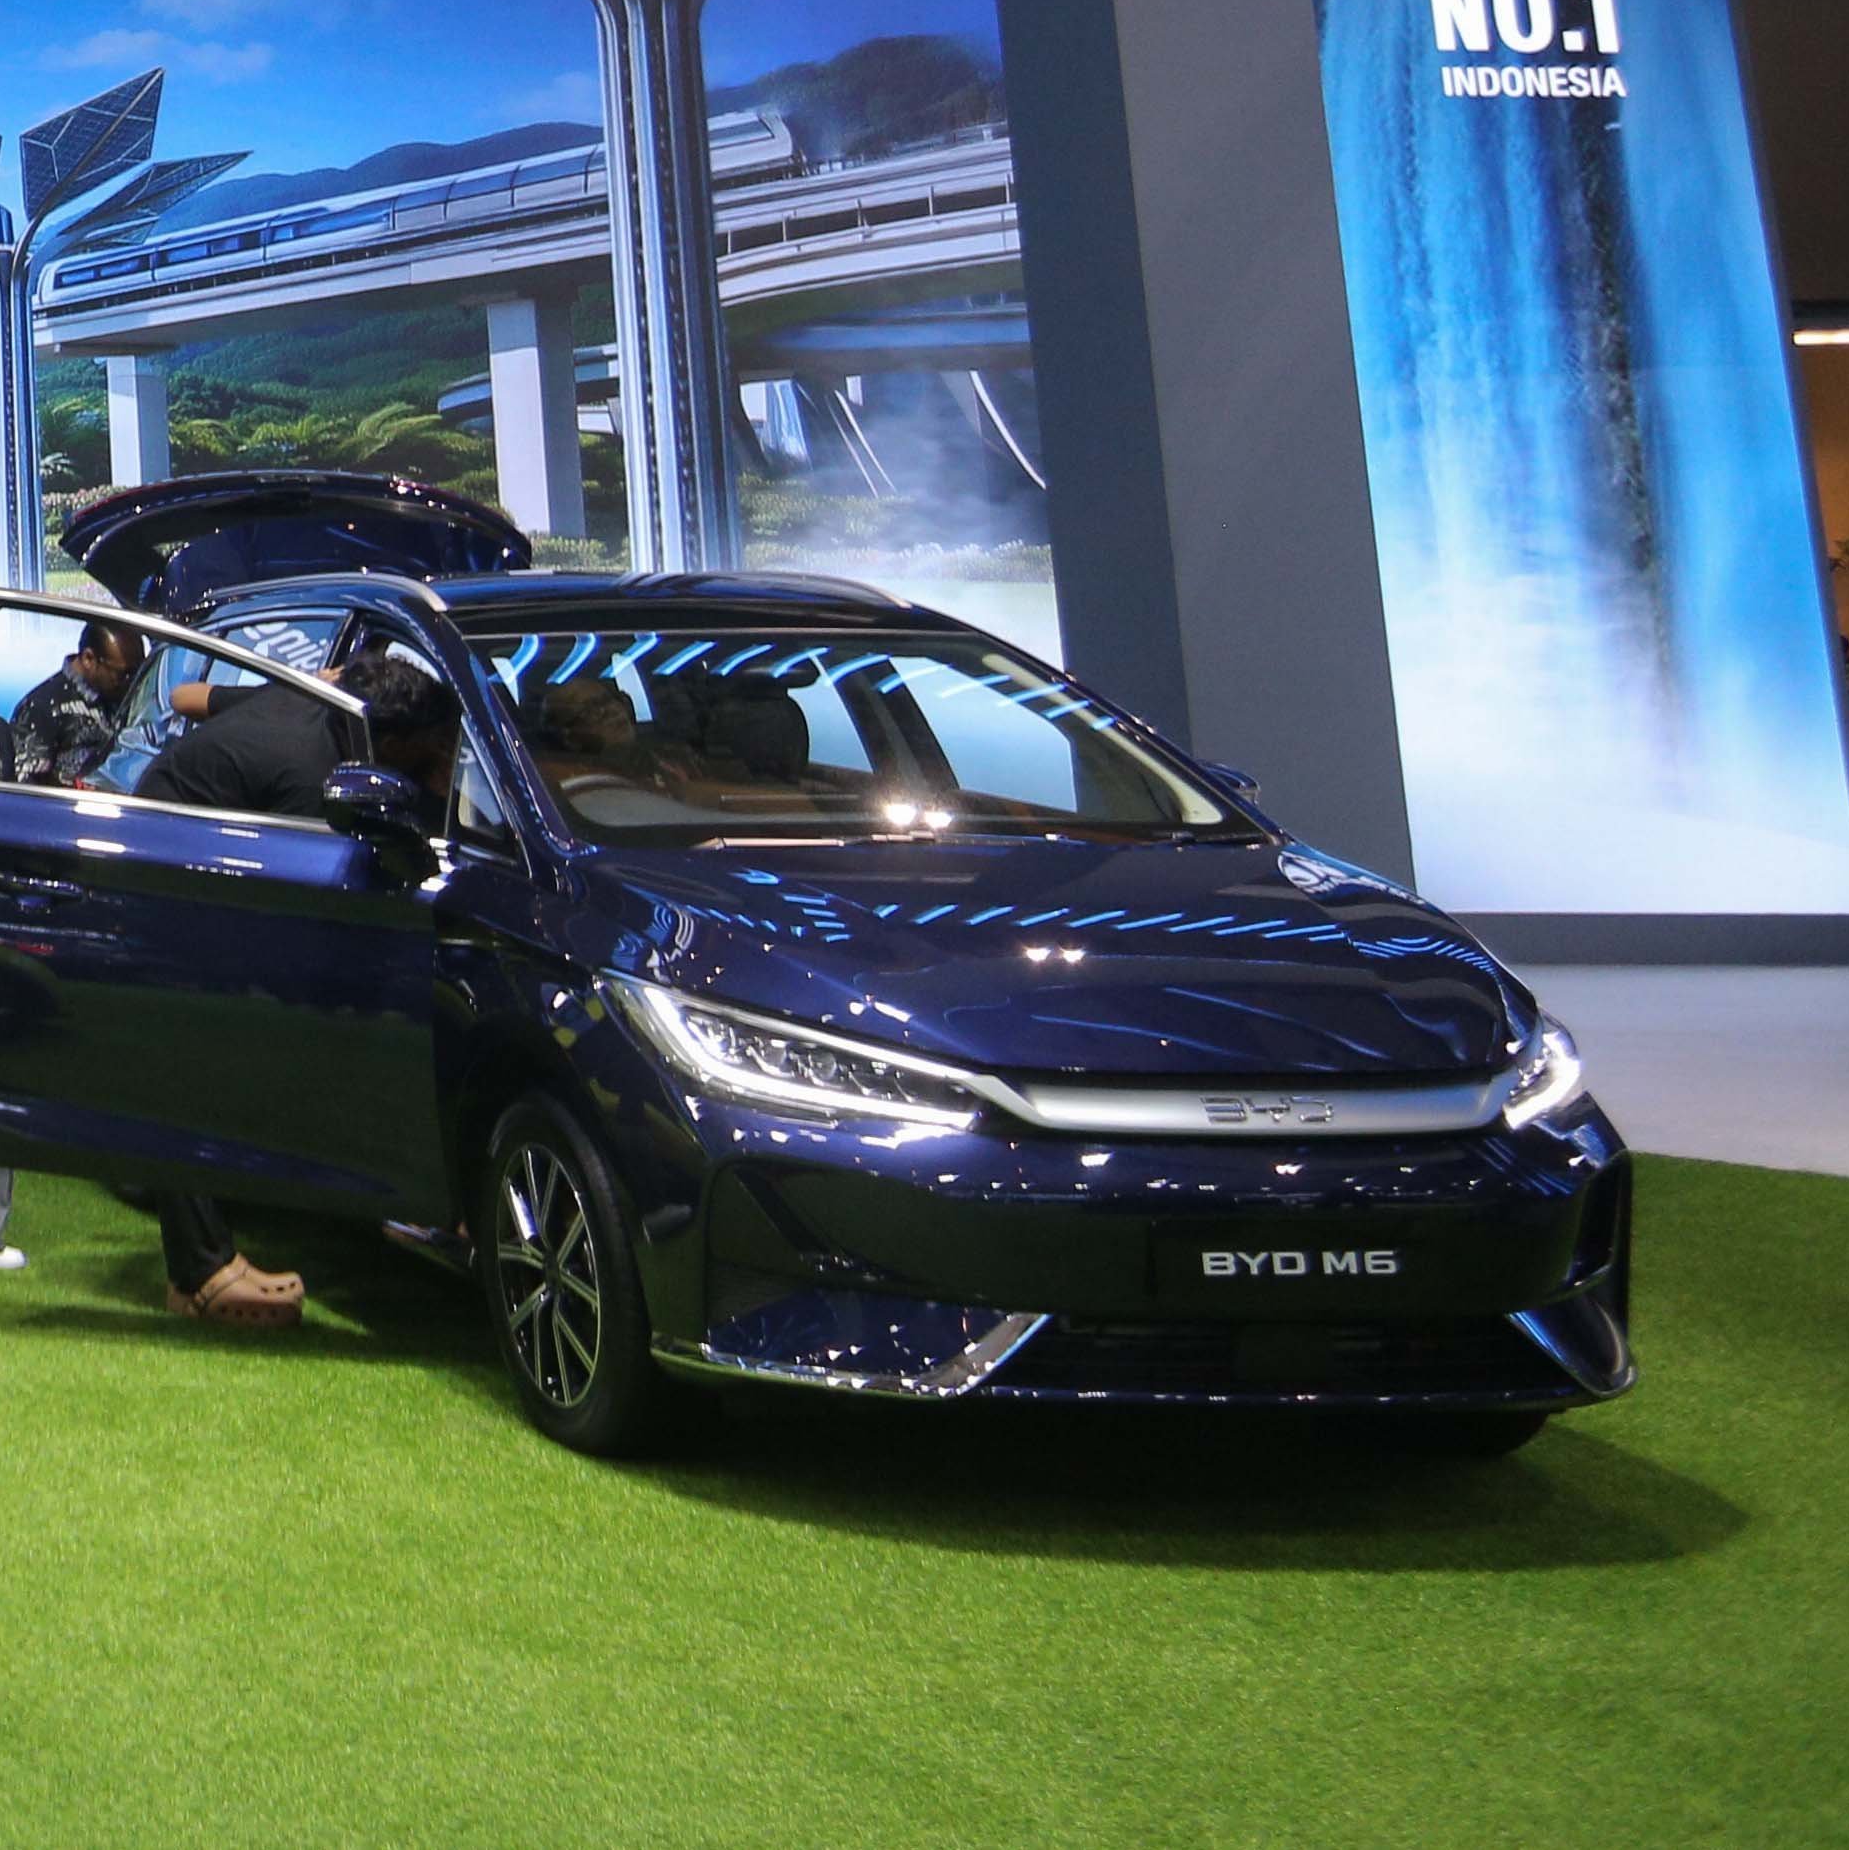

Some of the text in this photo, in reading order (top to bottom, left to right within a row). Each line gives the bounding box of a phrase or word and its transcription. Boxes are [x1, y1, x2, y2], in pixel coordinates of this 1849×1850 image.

[1441, 66, 1628, 98] INDONESIA
[1200, 1095, 1334, 1123] BYD
[1202, 1250, 1398, 1276] BYD M6
